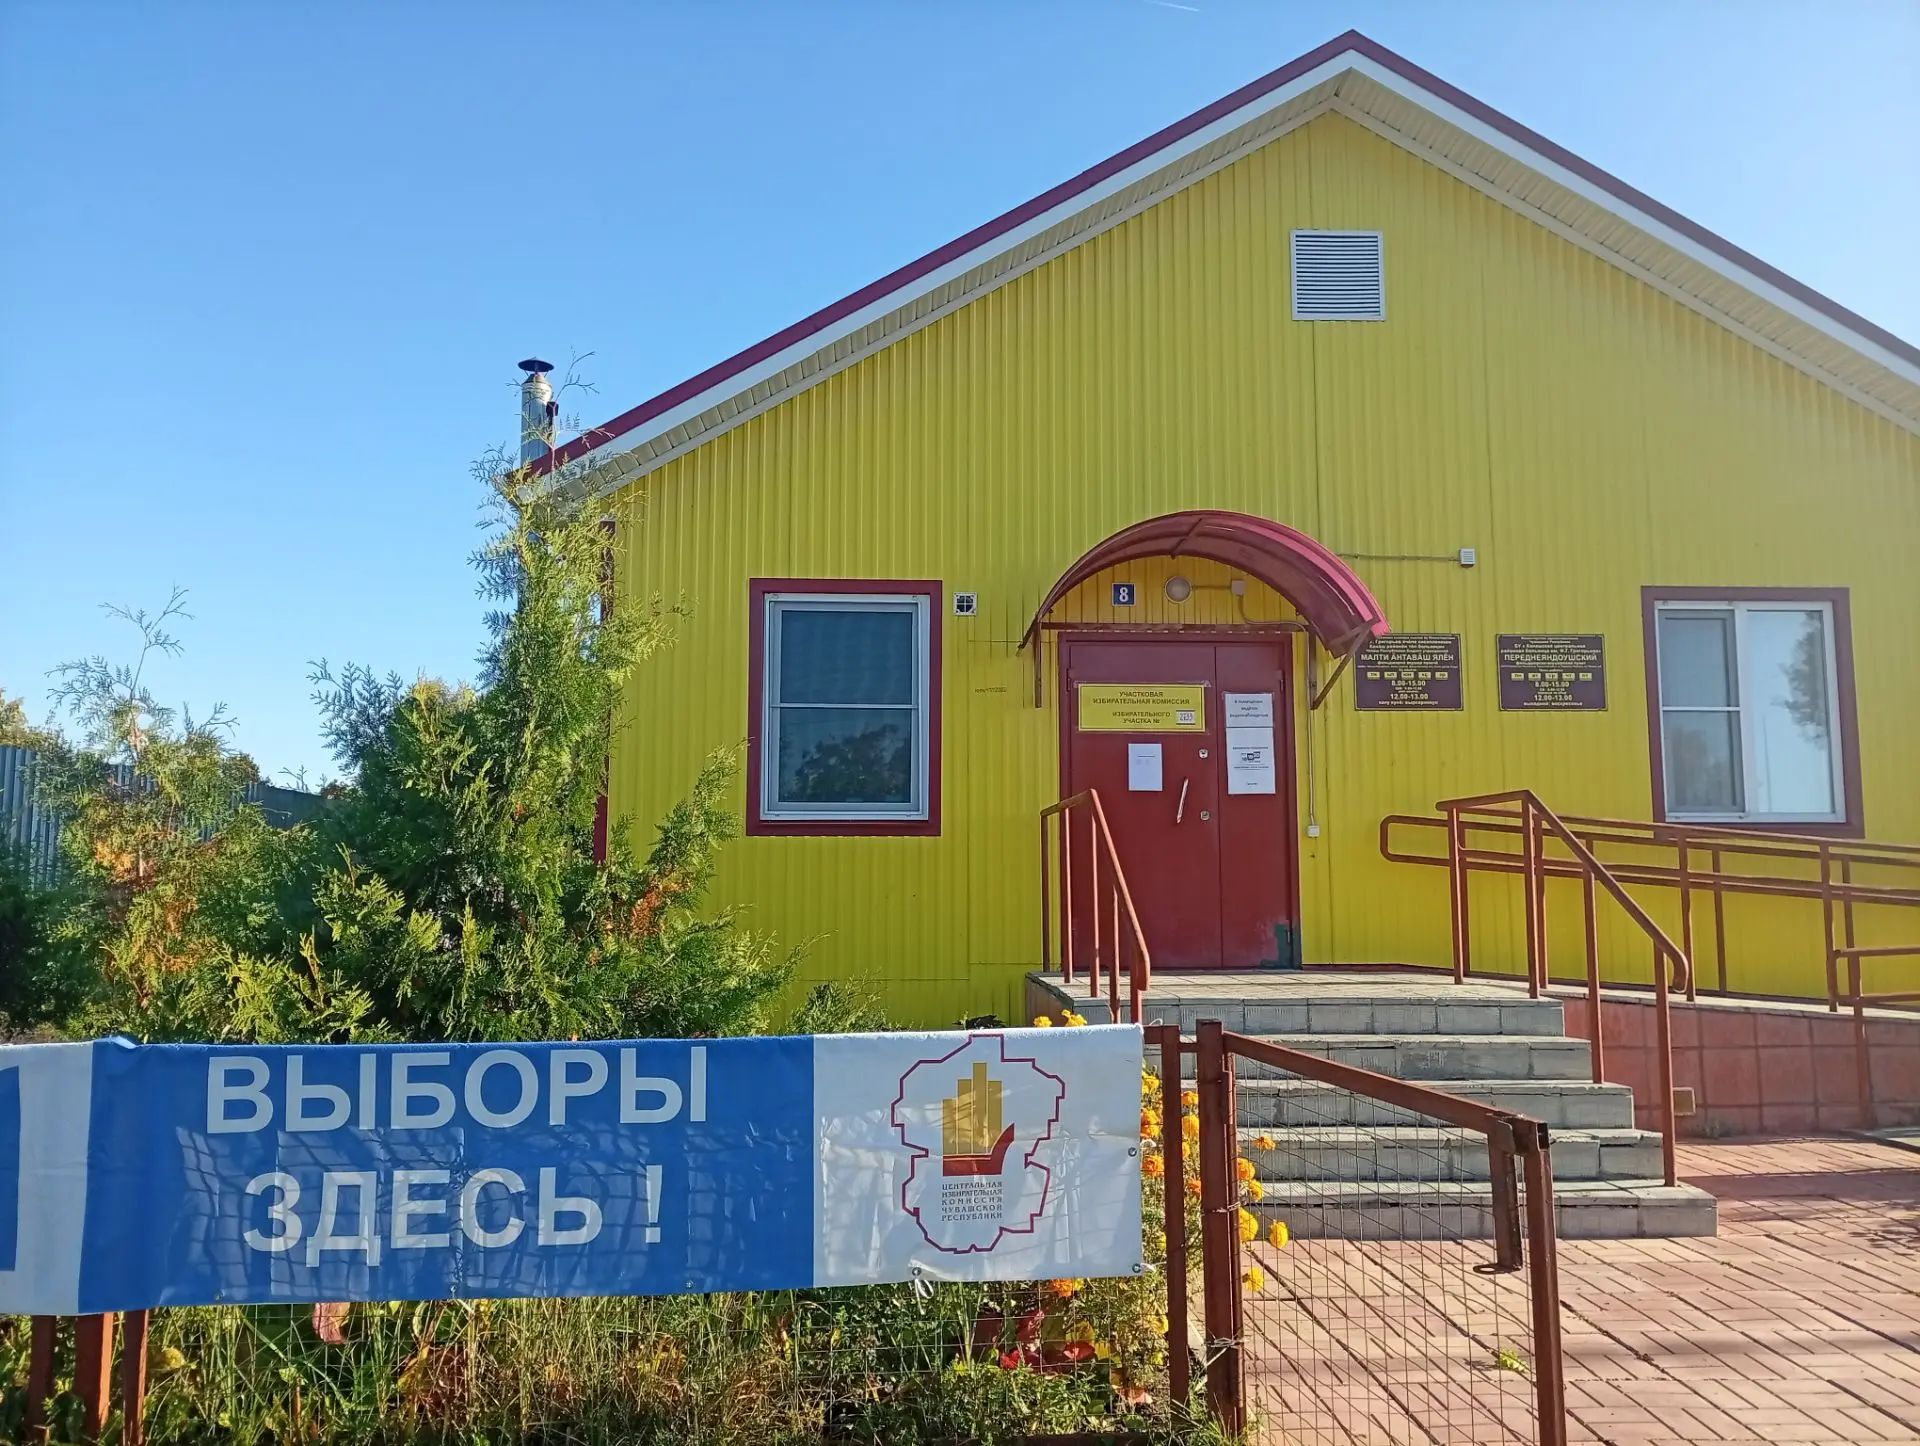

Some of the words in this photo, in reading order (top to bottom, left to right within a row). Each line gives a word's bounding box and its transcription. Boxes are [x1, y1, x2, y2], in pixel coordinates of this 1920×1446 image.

[1119, 587, 1129, 602] 8
[1504, 653, 1597, 661] ПЕРЕДНЕЯНДОУШСКИЙ
[207, 1046, 707, 1134] ВЫБОРЫ
[942, 1181, 1003, 1190] ЦЕНТРАЛЬНАЯ
[942, 1189, 1003, 1198] ИЗБИРАТЕЛЬНАЯ
[942, 1197, 1003, 1206] КОМИССИЯ
[942, 1204, 1003, 1213] ЧУВАШСКОЙ
[243, 1167, 603, 1267] ЗДЕСЬ
[645, 1165, 663, 1243] !
[942, 1212, 1003, 1221] РЕСПУБЛИКИ
